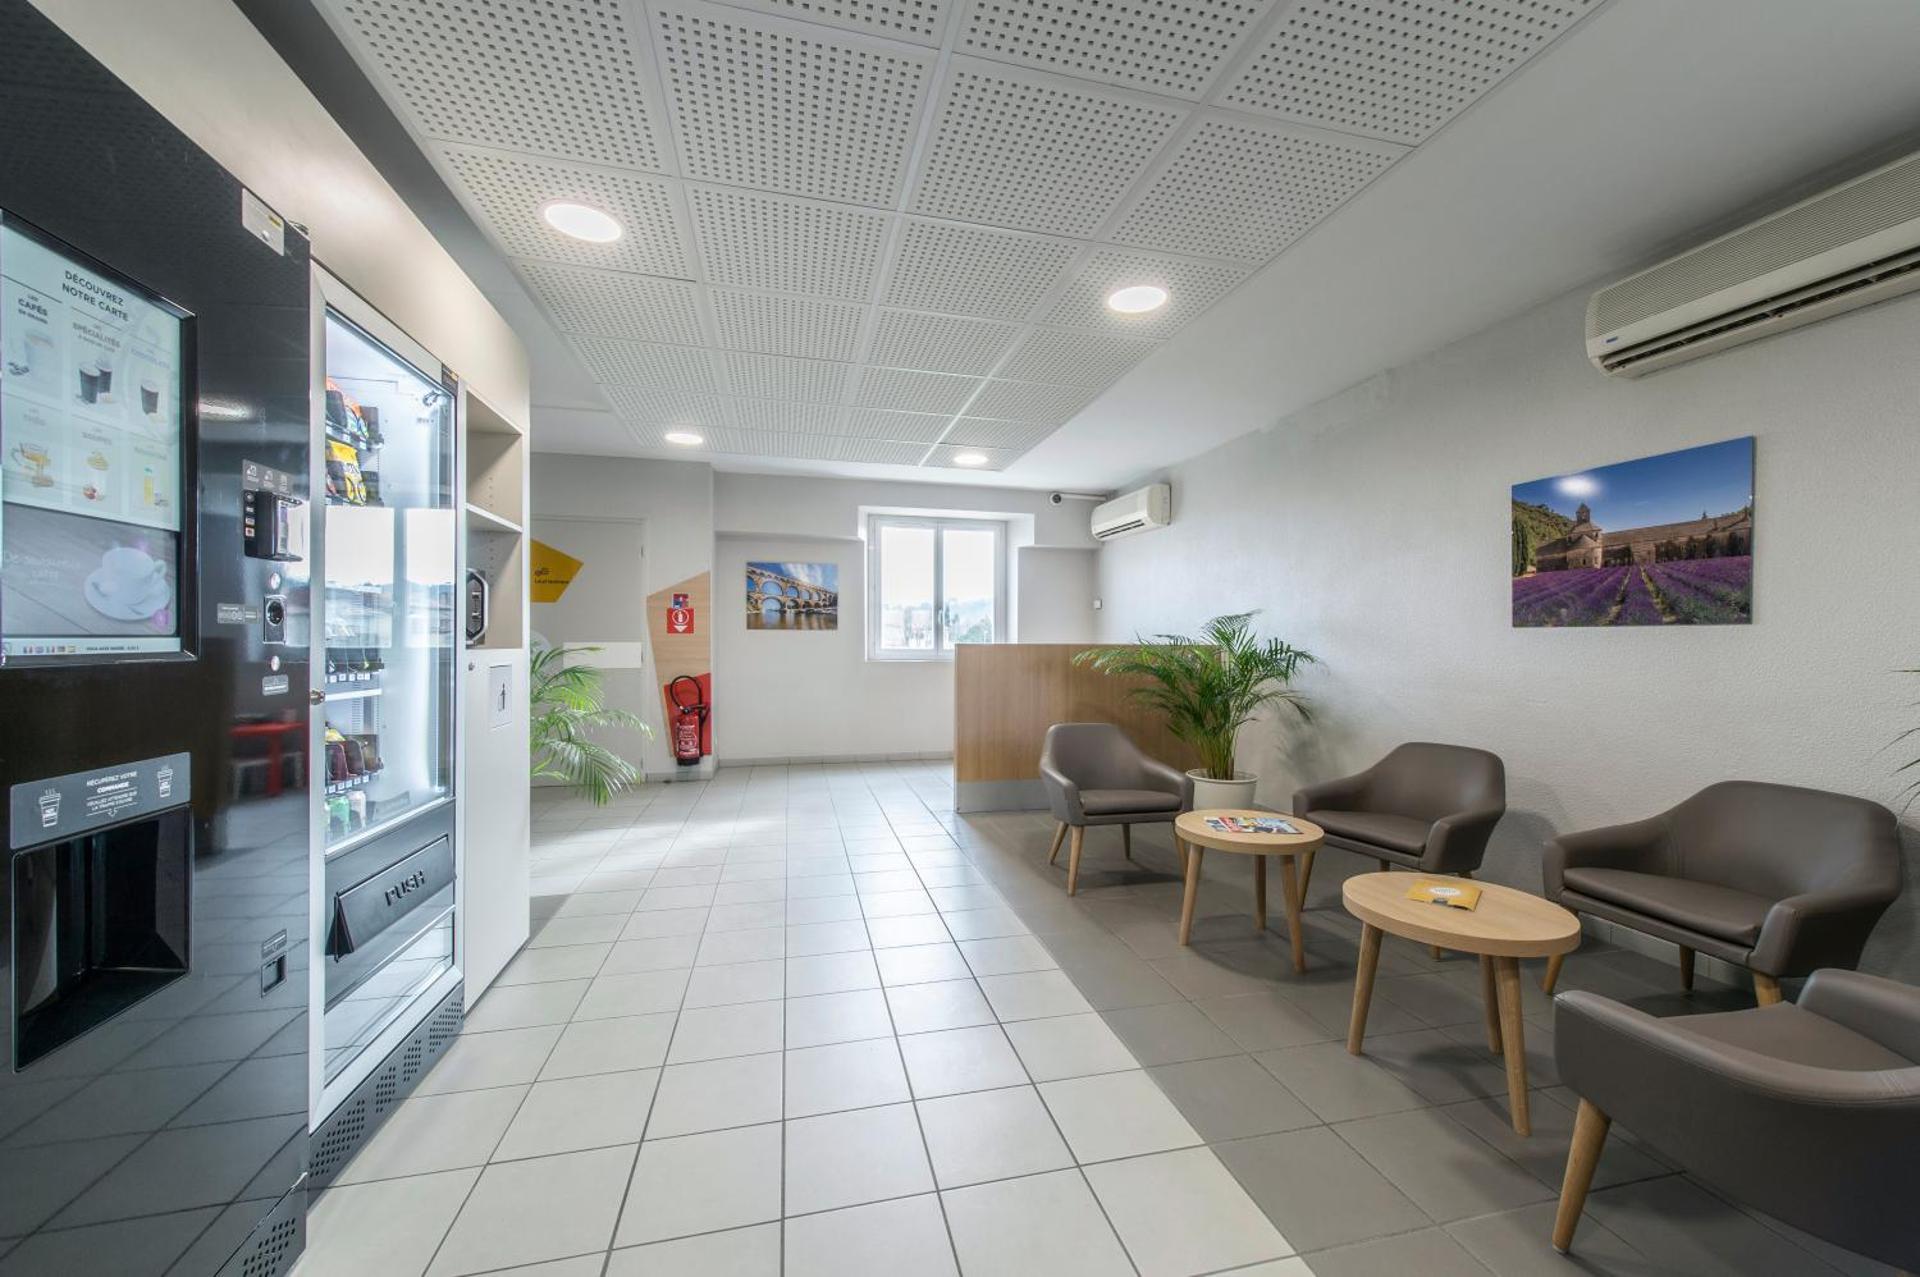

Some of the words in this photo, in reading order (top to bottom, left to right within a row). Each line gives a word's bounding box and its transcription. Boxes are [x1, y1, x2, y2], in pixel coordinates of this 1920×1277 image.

[62, 283, 96, 306] NOTRE
[98, 301, 129, 322] CARTE
[65, 270, 124, 306] DÉCOUVREZ
[385, 870, 425, 907] PUSH
